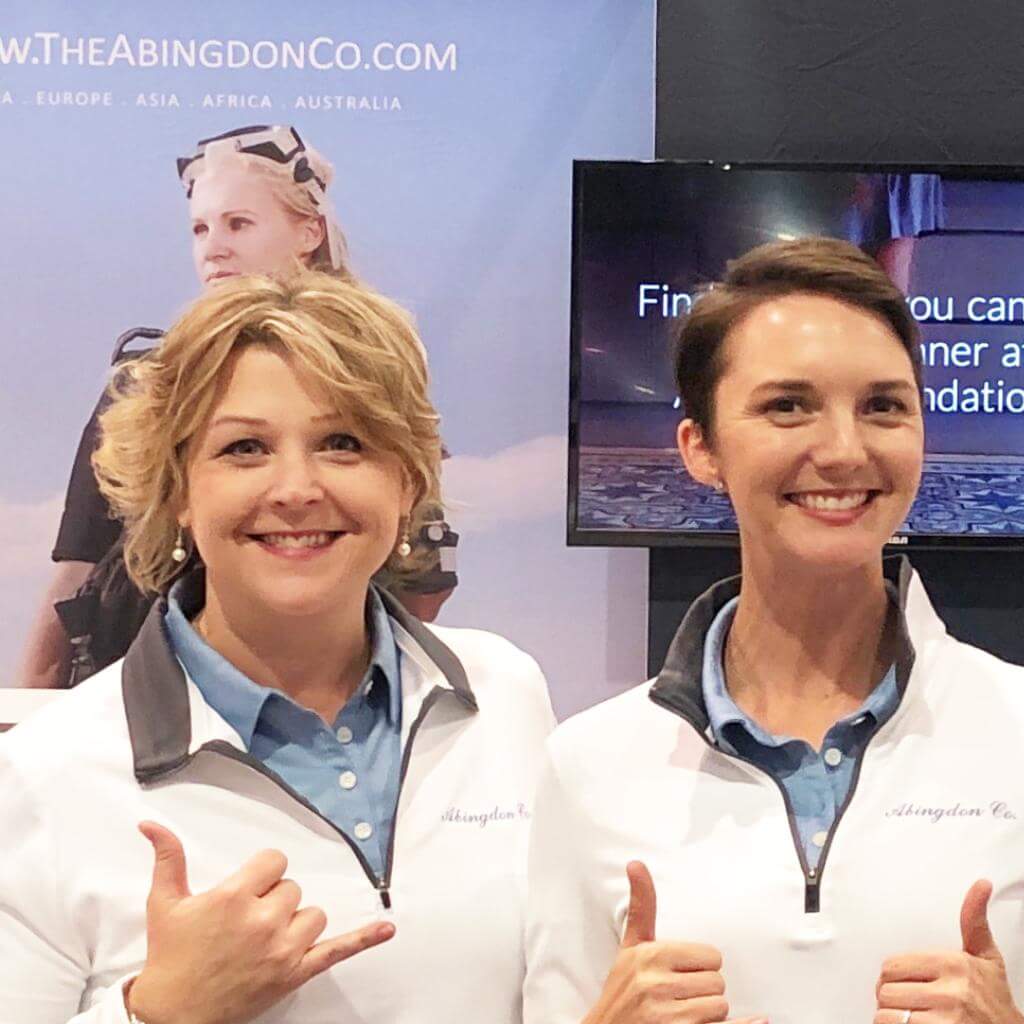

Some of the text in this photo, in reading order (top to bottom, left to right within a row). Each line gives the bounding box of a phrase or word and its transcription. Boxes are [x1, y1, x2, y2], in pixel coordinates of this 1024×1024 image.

[36, 91, 113, 106] EUROPE
[136, 92, 180, 107] ASIA
[202, 93, 272, 109] AFRICA
[294, 95, 403, 110] AUSTRALIA
[905, 296, 953, 321] ou
[885, 802, 985, 824] Abingdon
